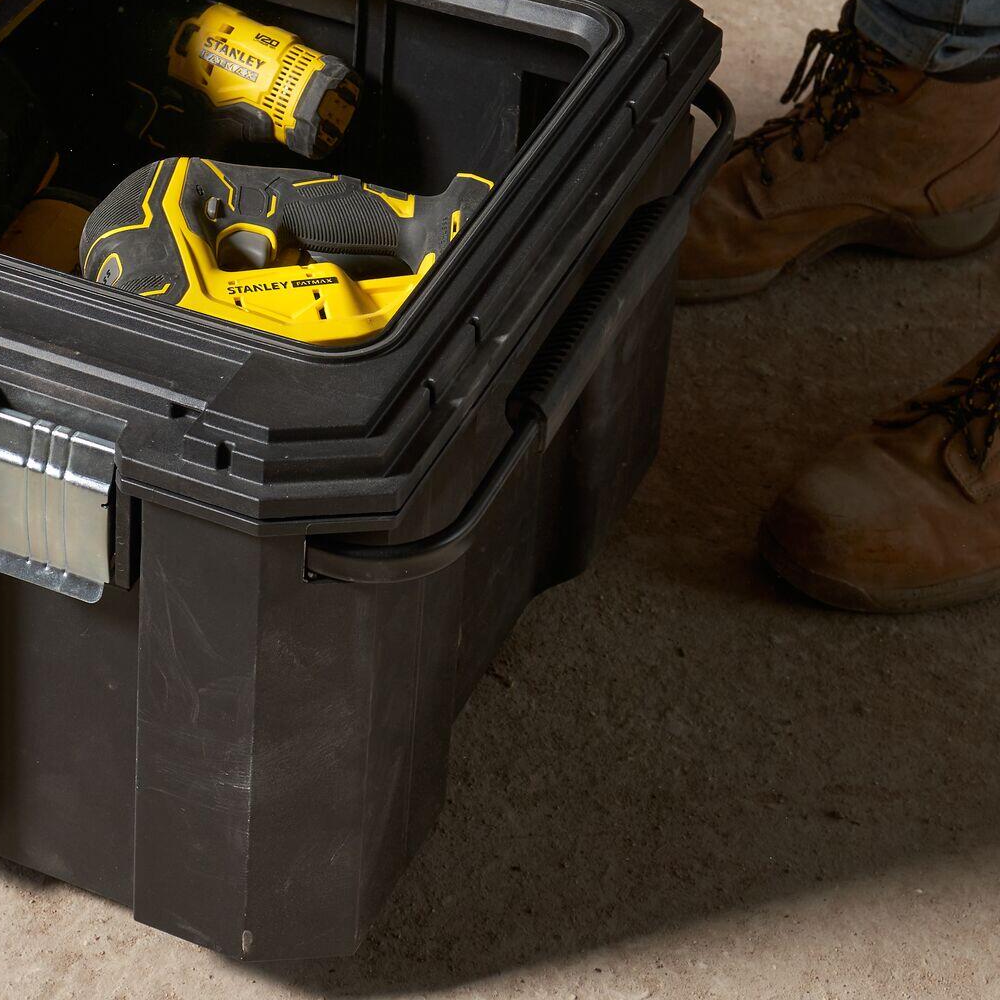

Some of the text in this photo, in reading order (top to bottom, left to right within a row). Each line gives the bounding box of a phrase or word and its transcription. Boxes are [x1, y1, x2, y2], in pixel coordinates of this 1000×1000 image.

[255, 32, 280, 48] V20
[203, 36, 266, 70] STANLEY
[227, 278, 334, 295] STANLEY FATMAX
